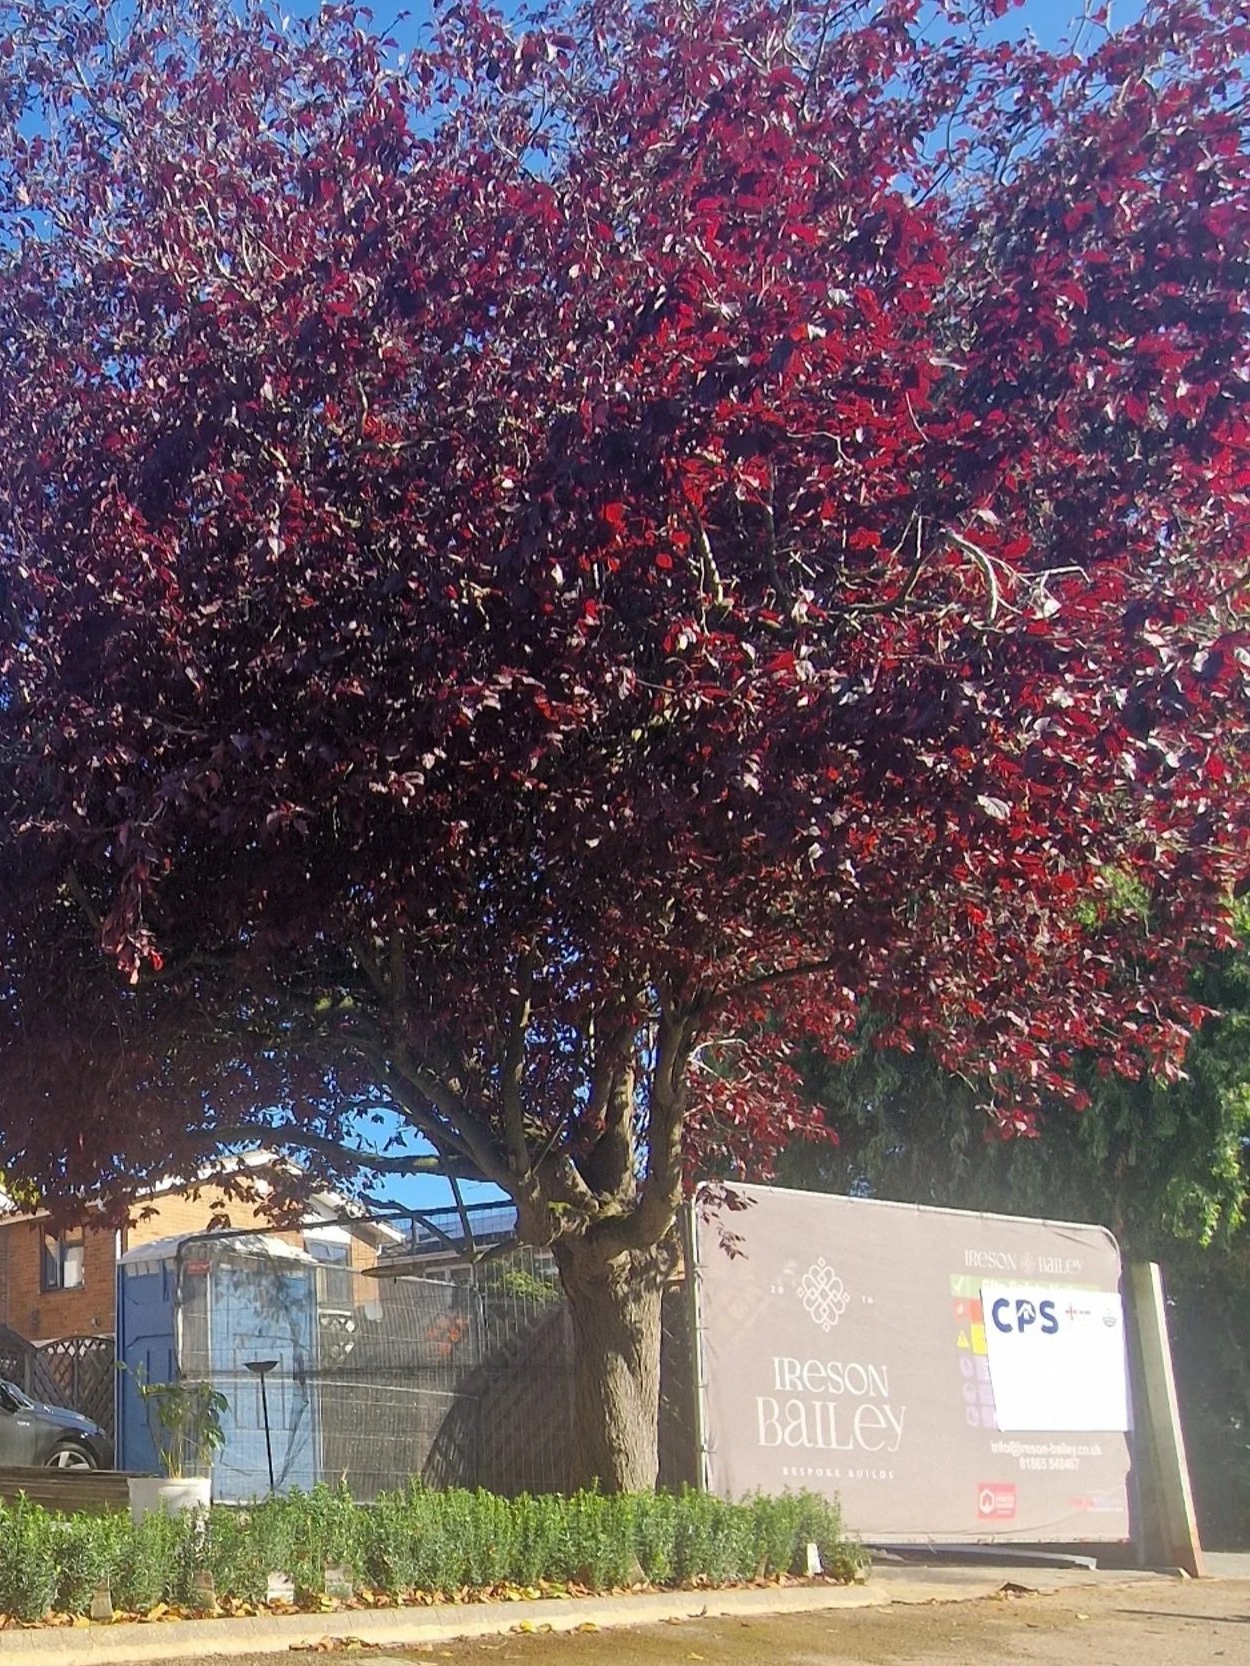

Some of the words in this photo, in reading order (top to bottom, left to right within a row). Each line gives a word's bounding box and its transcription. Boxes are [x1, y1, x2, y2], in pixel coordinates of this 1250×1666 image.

[991, 1298, 1059, 1334] CPS
[782, 1466, 841, 1478] BESPOKE
[848, 1469, 894, 1480] BUILDS
